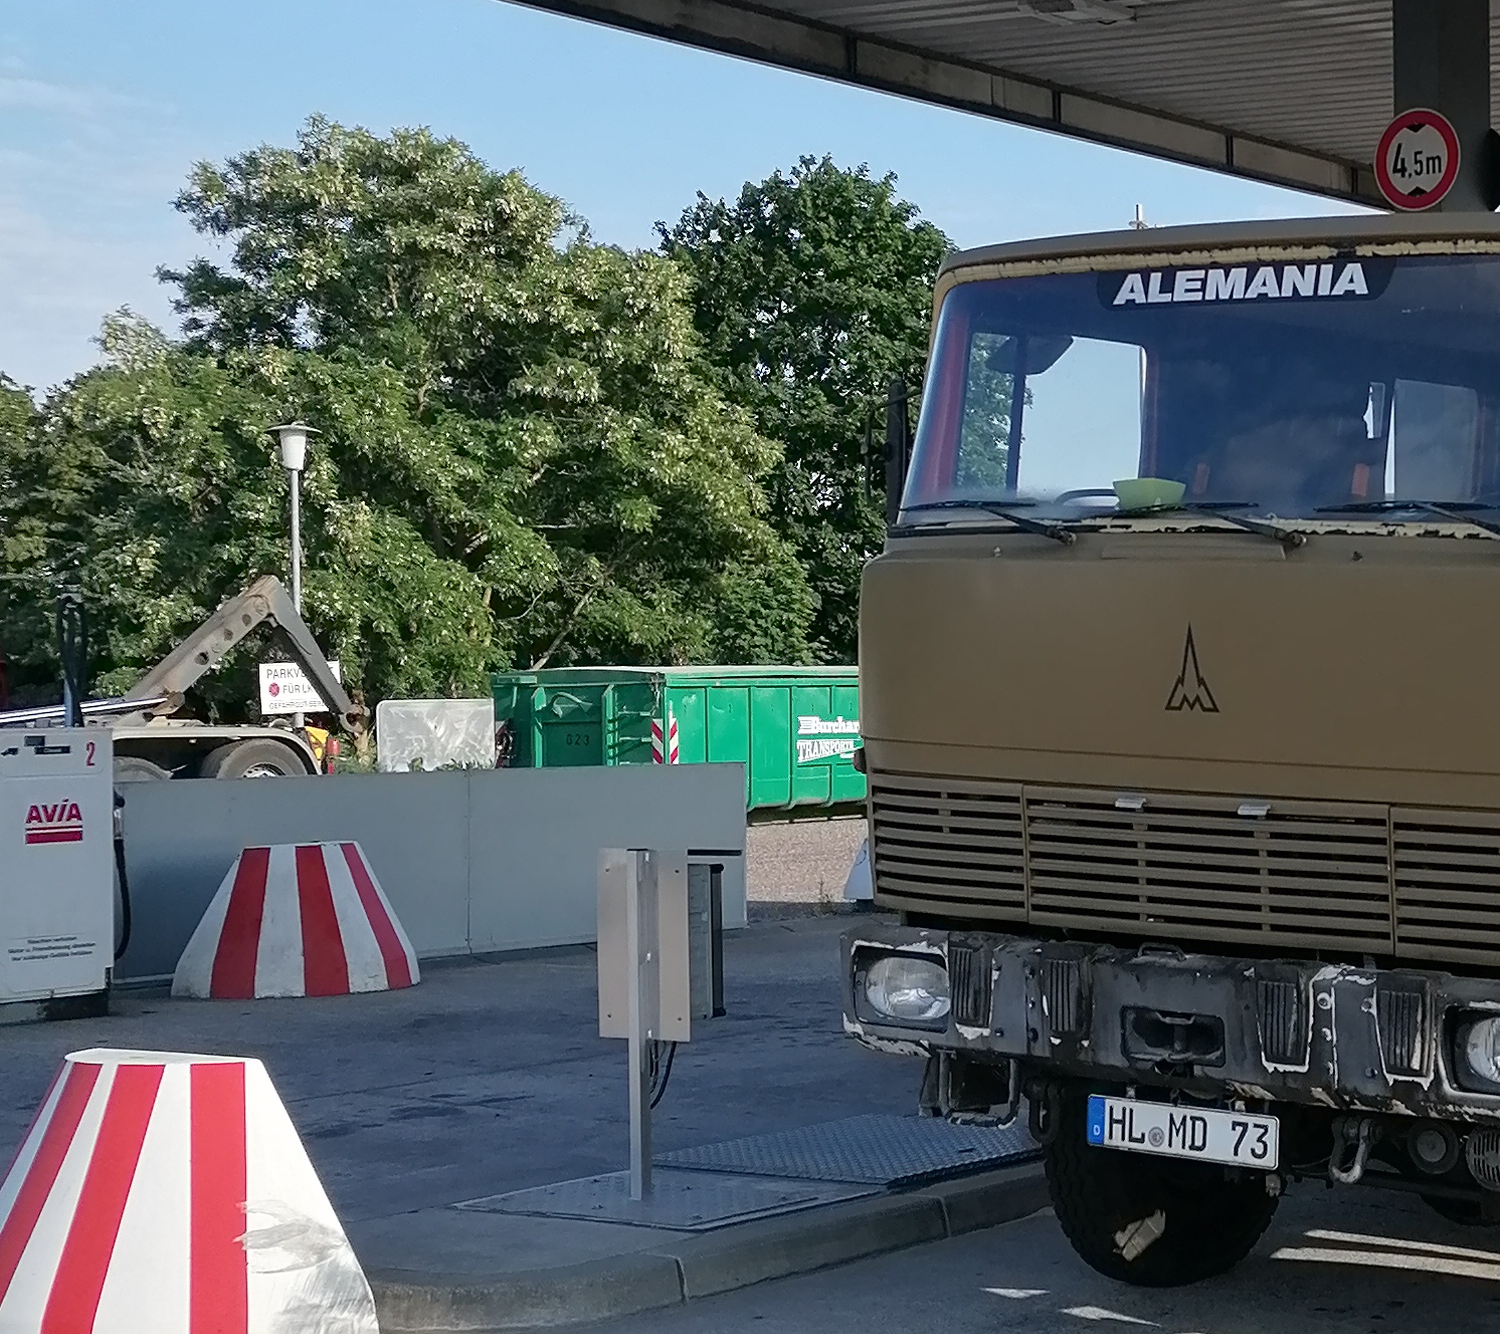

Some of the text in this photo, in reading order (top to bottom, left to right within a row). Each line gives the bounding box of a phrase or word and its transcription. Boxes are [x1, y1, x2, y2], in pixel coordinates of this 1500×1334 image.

[1392, 142, 1442, 179] 4,5m
[1112, 262, 1369, 306] ALEMANIA
[282, 682, 300, 694] FÜR
[86, 741, 96, 766] 2
[1108, 1104, 1269, 1160] HL MD 73
